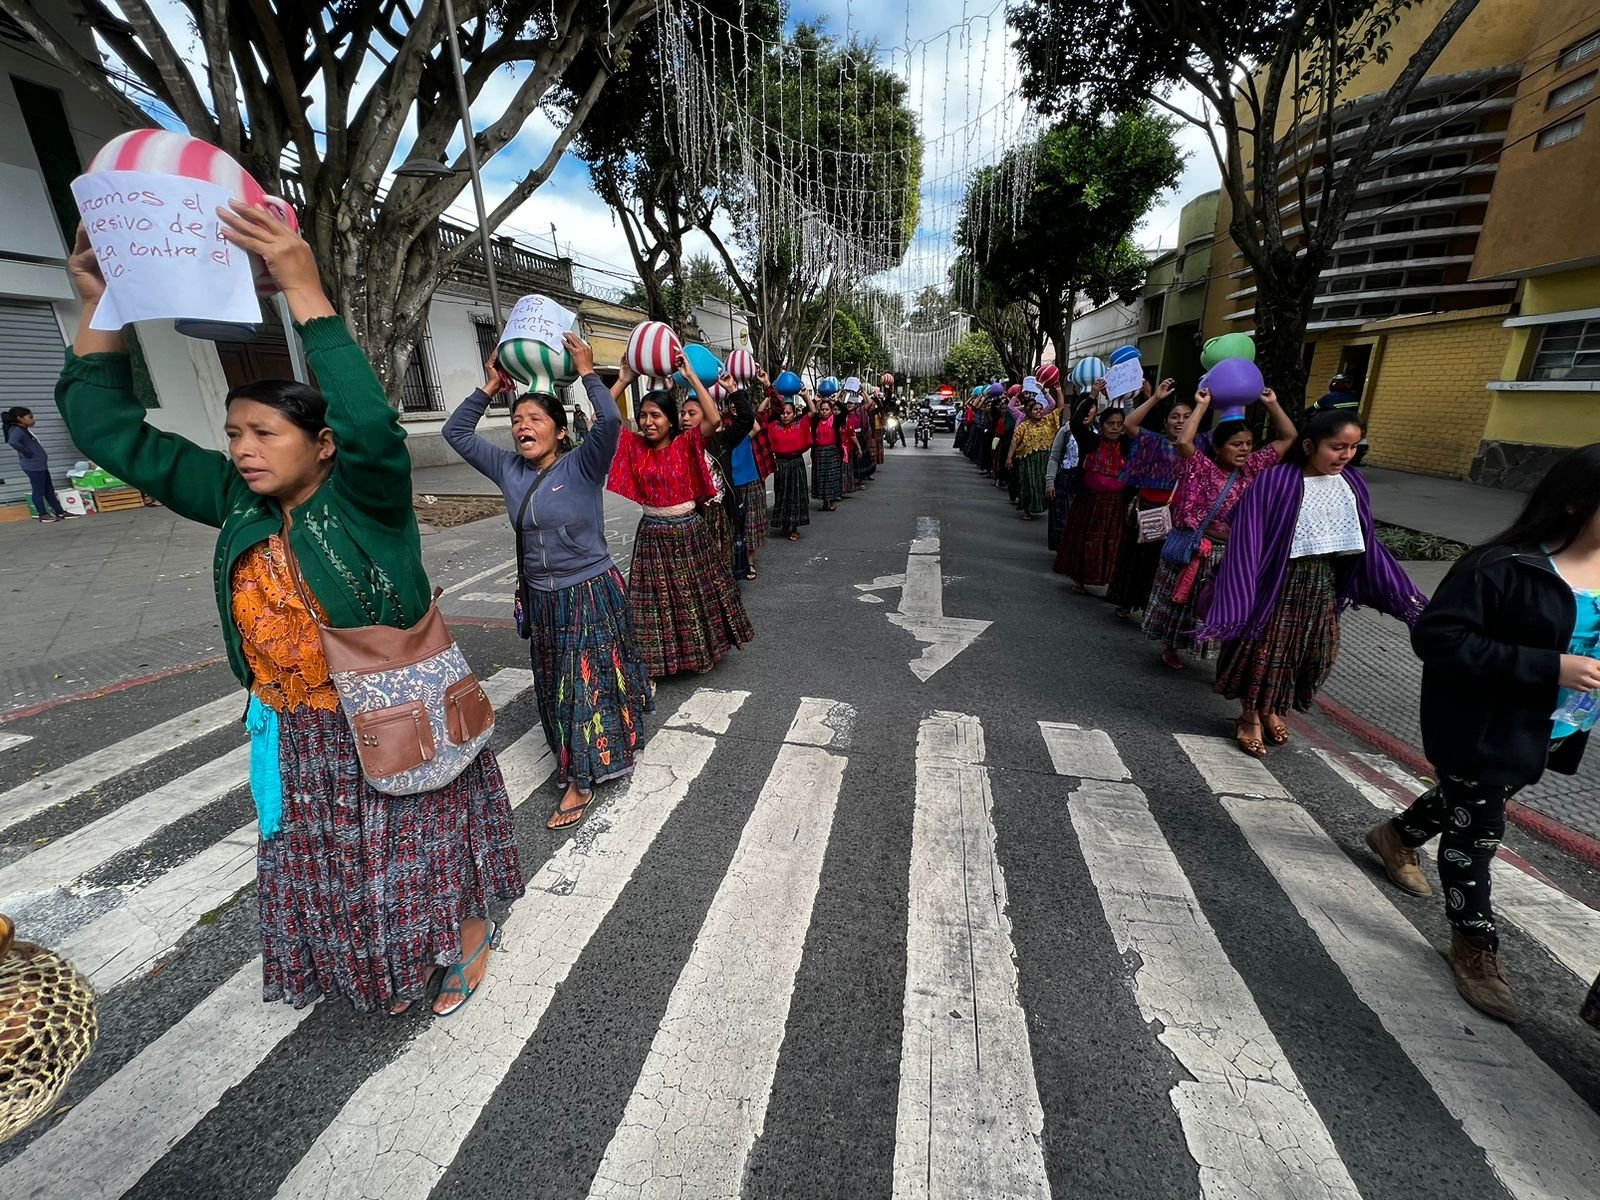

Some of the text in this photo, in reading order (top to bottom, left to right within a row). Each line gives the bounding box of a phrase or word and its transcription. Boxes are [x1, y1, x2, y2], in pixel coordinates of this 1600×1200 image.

[182, 193, 203, 215] el
[169, 212, 207, 239] de
[130, 236, 197, 258] contra
[211, 248, 230, 267] el
